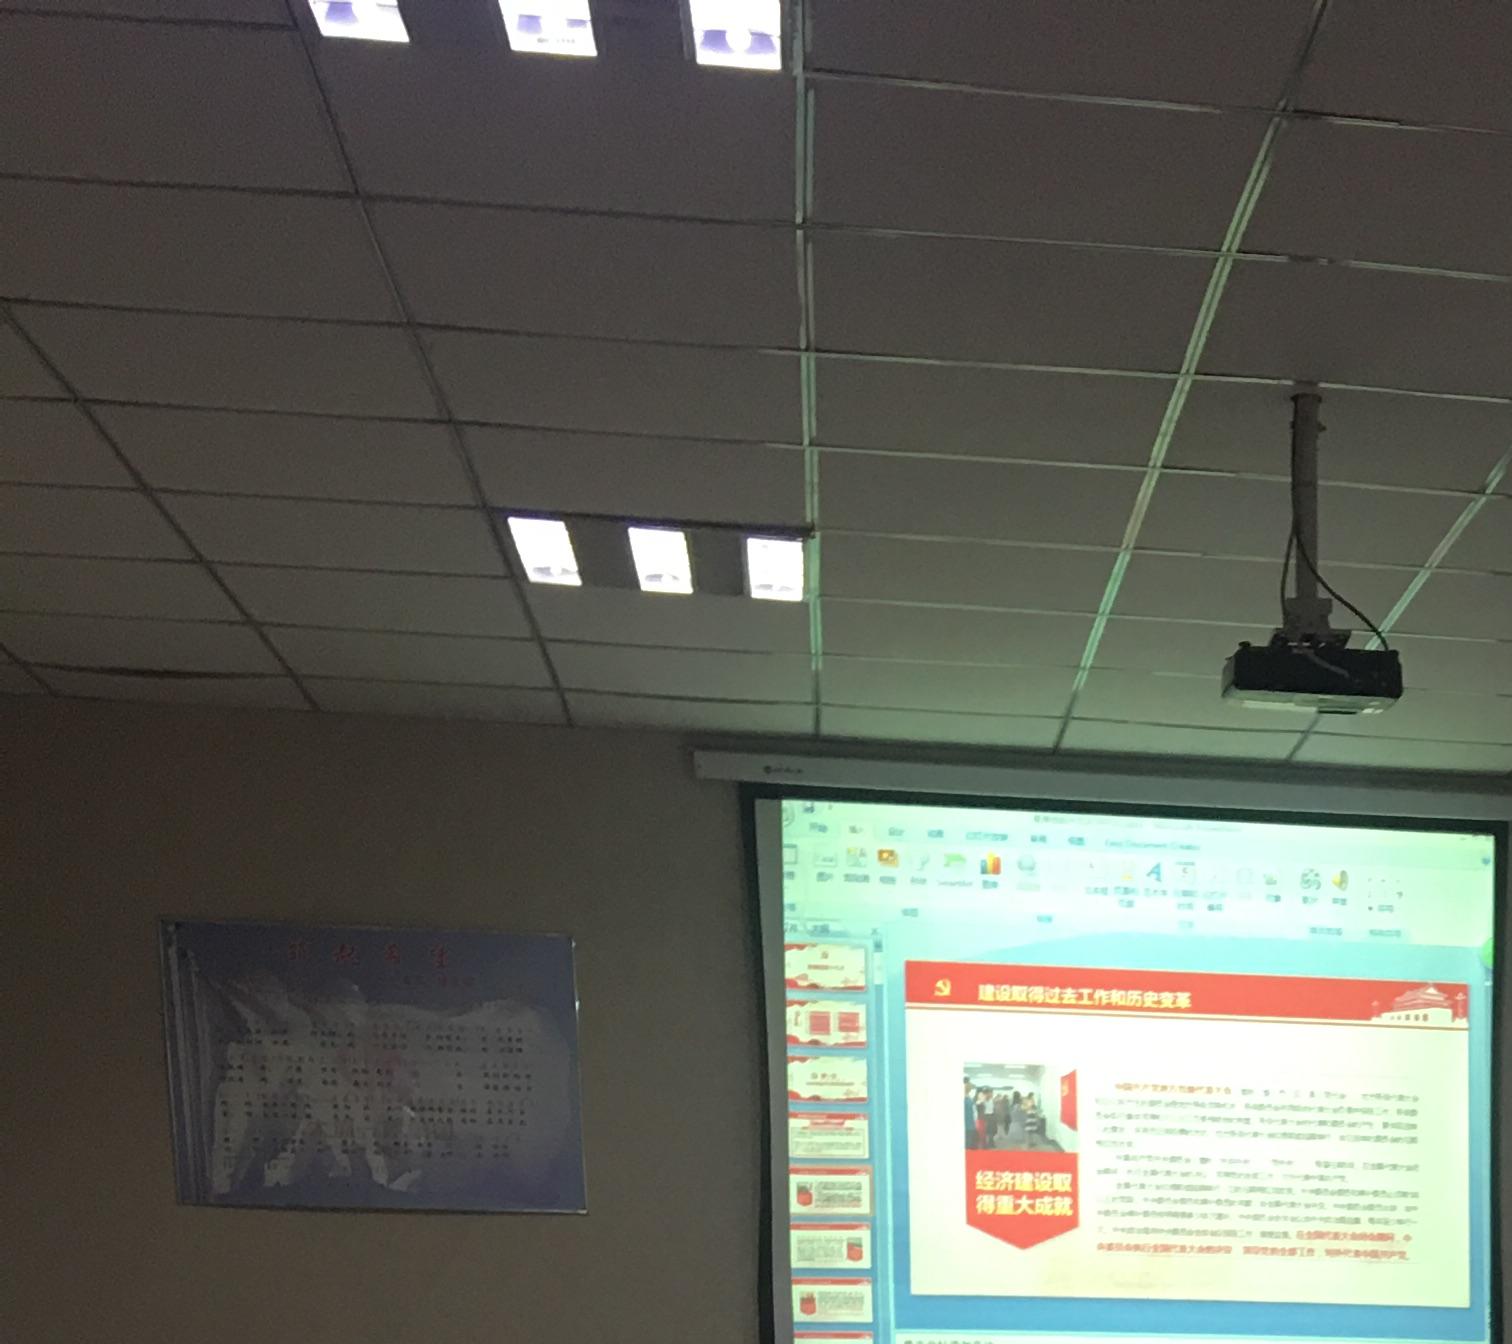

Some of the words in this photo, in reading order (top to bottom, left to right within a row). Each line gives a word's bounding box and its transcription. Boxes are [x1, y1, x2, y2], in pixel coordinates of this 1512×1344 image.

[977, 982, 1193, 1010] 建设取得过去工作和历史变革
[976, 1170, 1073, 1192] 经济建设取
[976, 1194, 1074, 1216] 得重大成就
